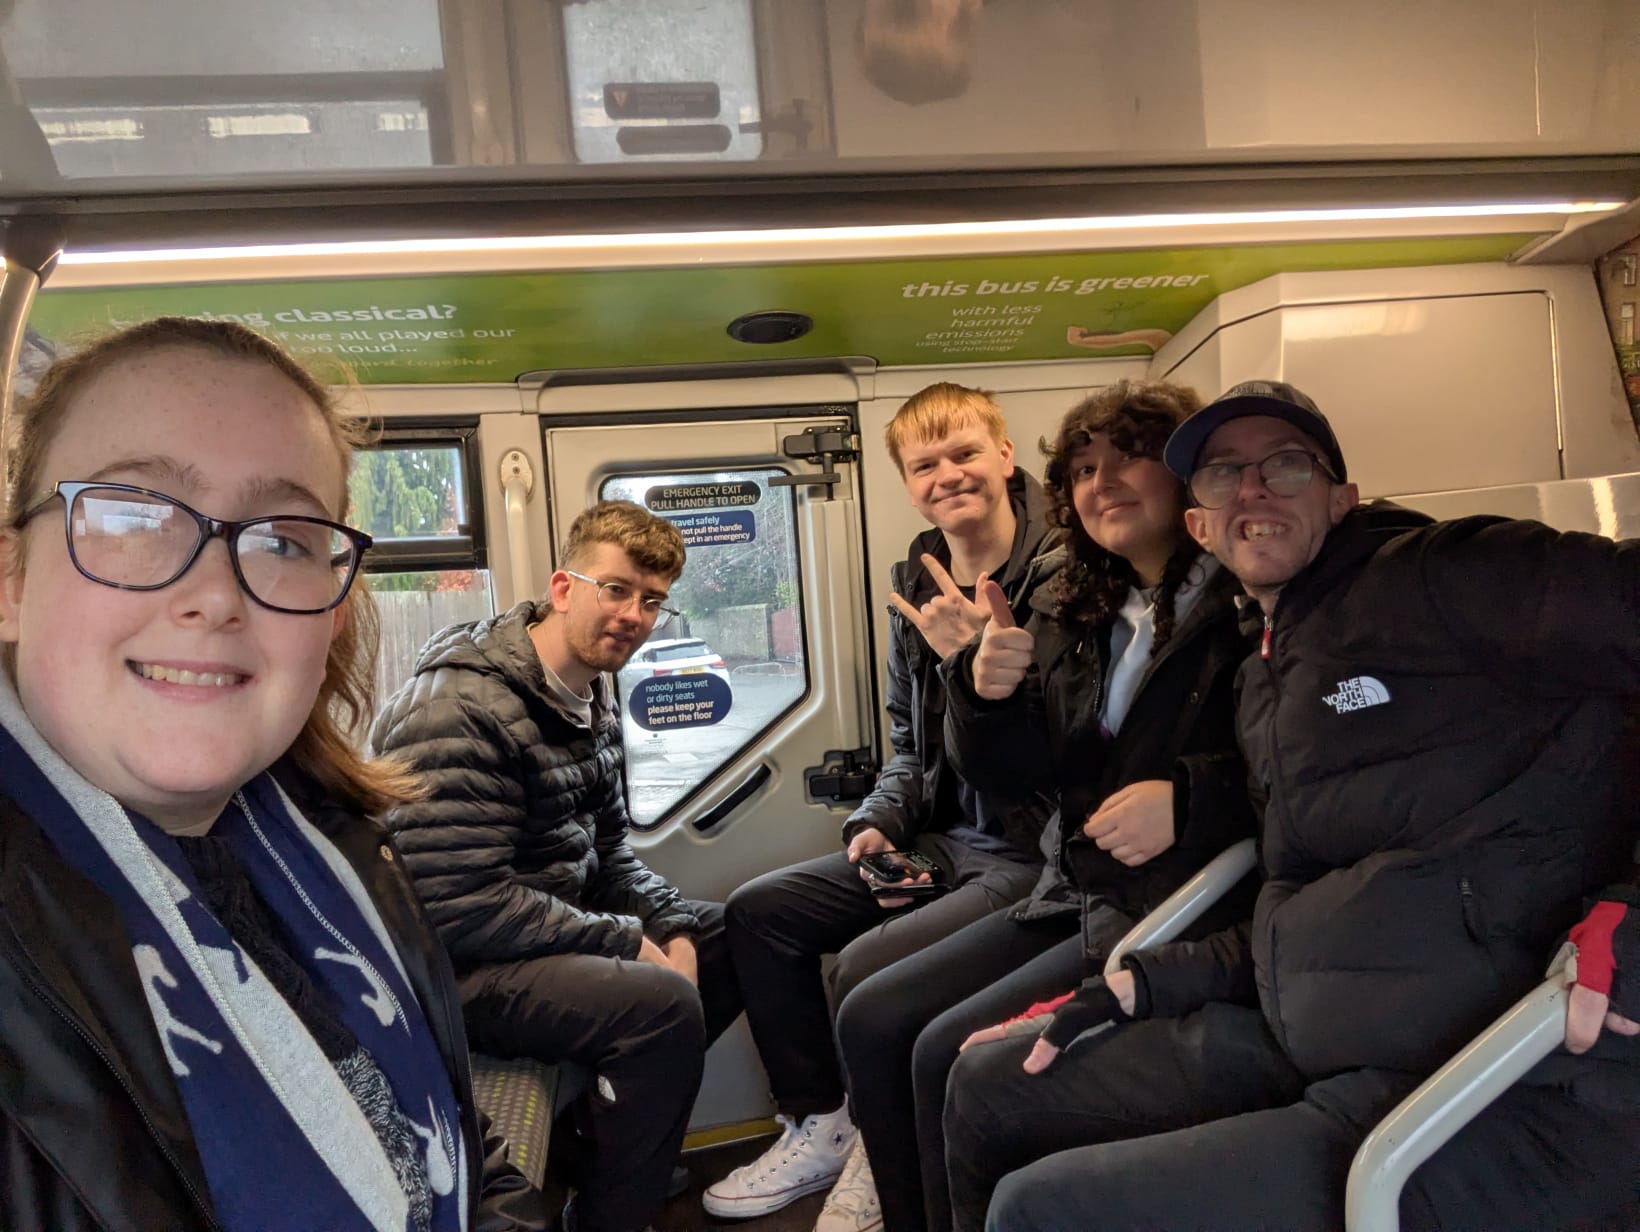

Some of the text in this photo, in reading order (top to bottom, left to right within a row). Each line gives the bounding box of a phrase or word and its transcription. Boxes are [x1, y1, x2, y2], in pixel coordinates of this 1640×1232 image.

[902, 274, 1209, 298] this bus is greener
[274, 304, 457, 323] classical?
[952, 304, 1042, 317] with less
[951, 315, 1035, 328] harmful
[295, 332, 332, 341] we
[340, 330, 373, 341] all
[378, 328, 464, 342] played
[472, 328, 516, 338] our
[925, 328, 1025, 339] emissions
[338, 343, 418, 353] loud...
[663, 484, 742, 498] EMERGENCY EXIT
[651, 494, 756, 510] PULL HANDLE TO OPEN
[672, 515, 720, 527] travel safely
[681, 523, 742, 535] not pull the handle
[696, 535, 703, 543] in
[714, 532, 750, 542] emergency
[646, 680, 708, 693] nobody likes wet
[1337, 677, 1360, 693] THE
[646, 691, 695, 703] or dirty seats
[1322, 687, 1364, 706] NORTH
[647, 700, 714, 715] please keep your
[1336, 697, 1366, 714] FACE
[648, 711, 712, 725] feet on the floor
